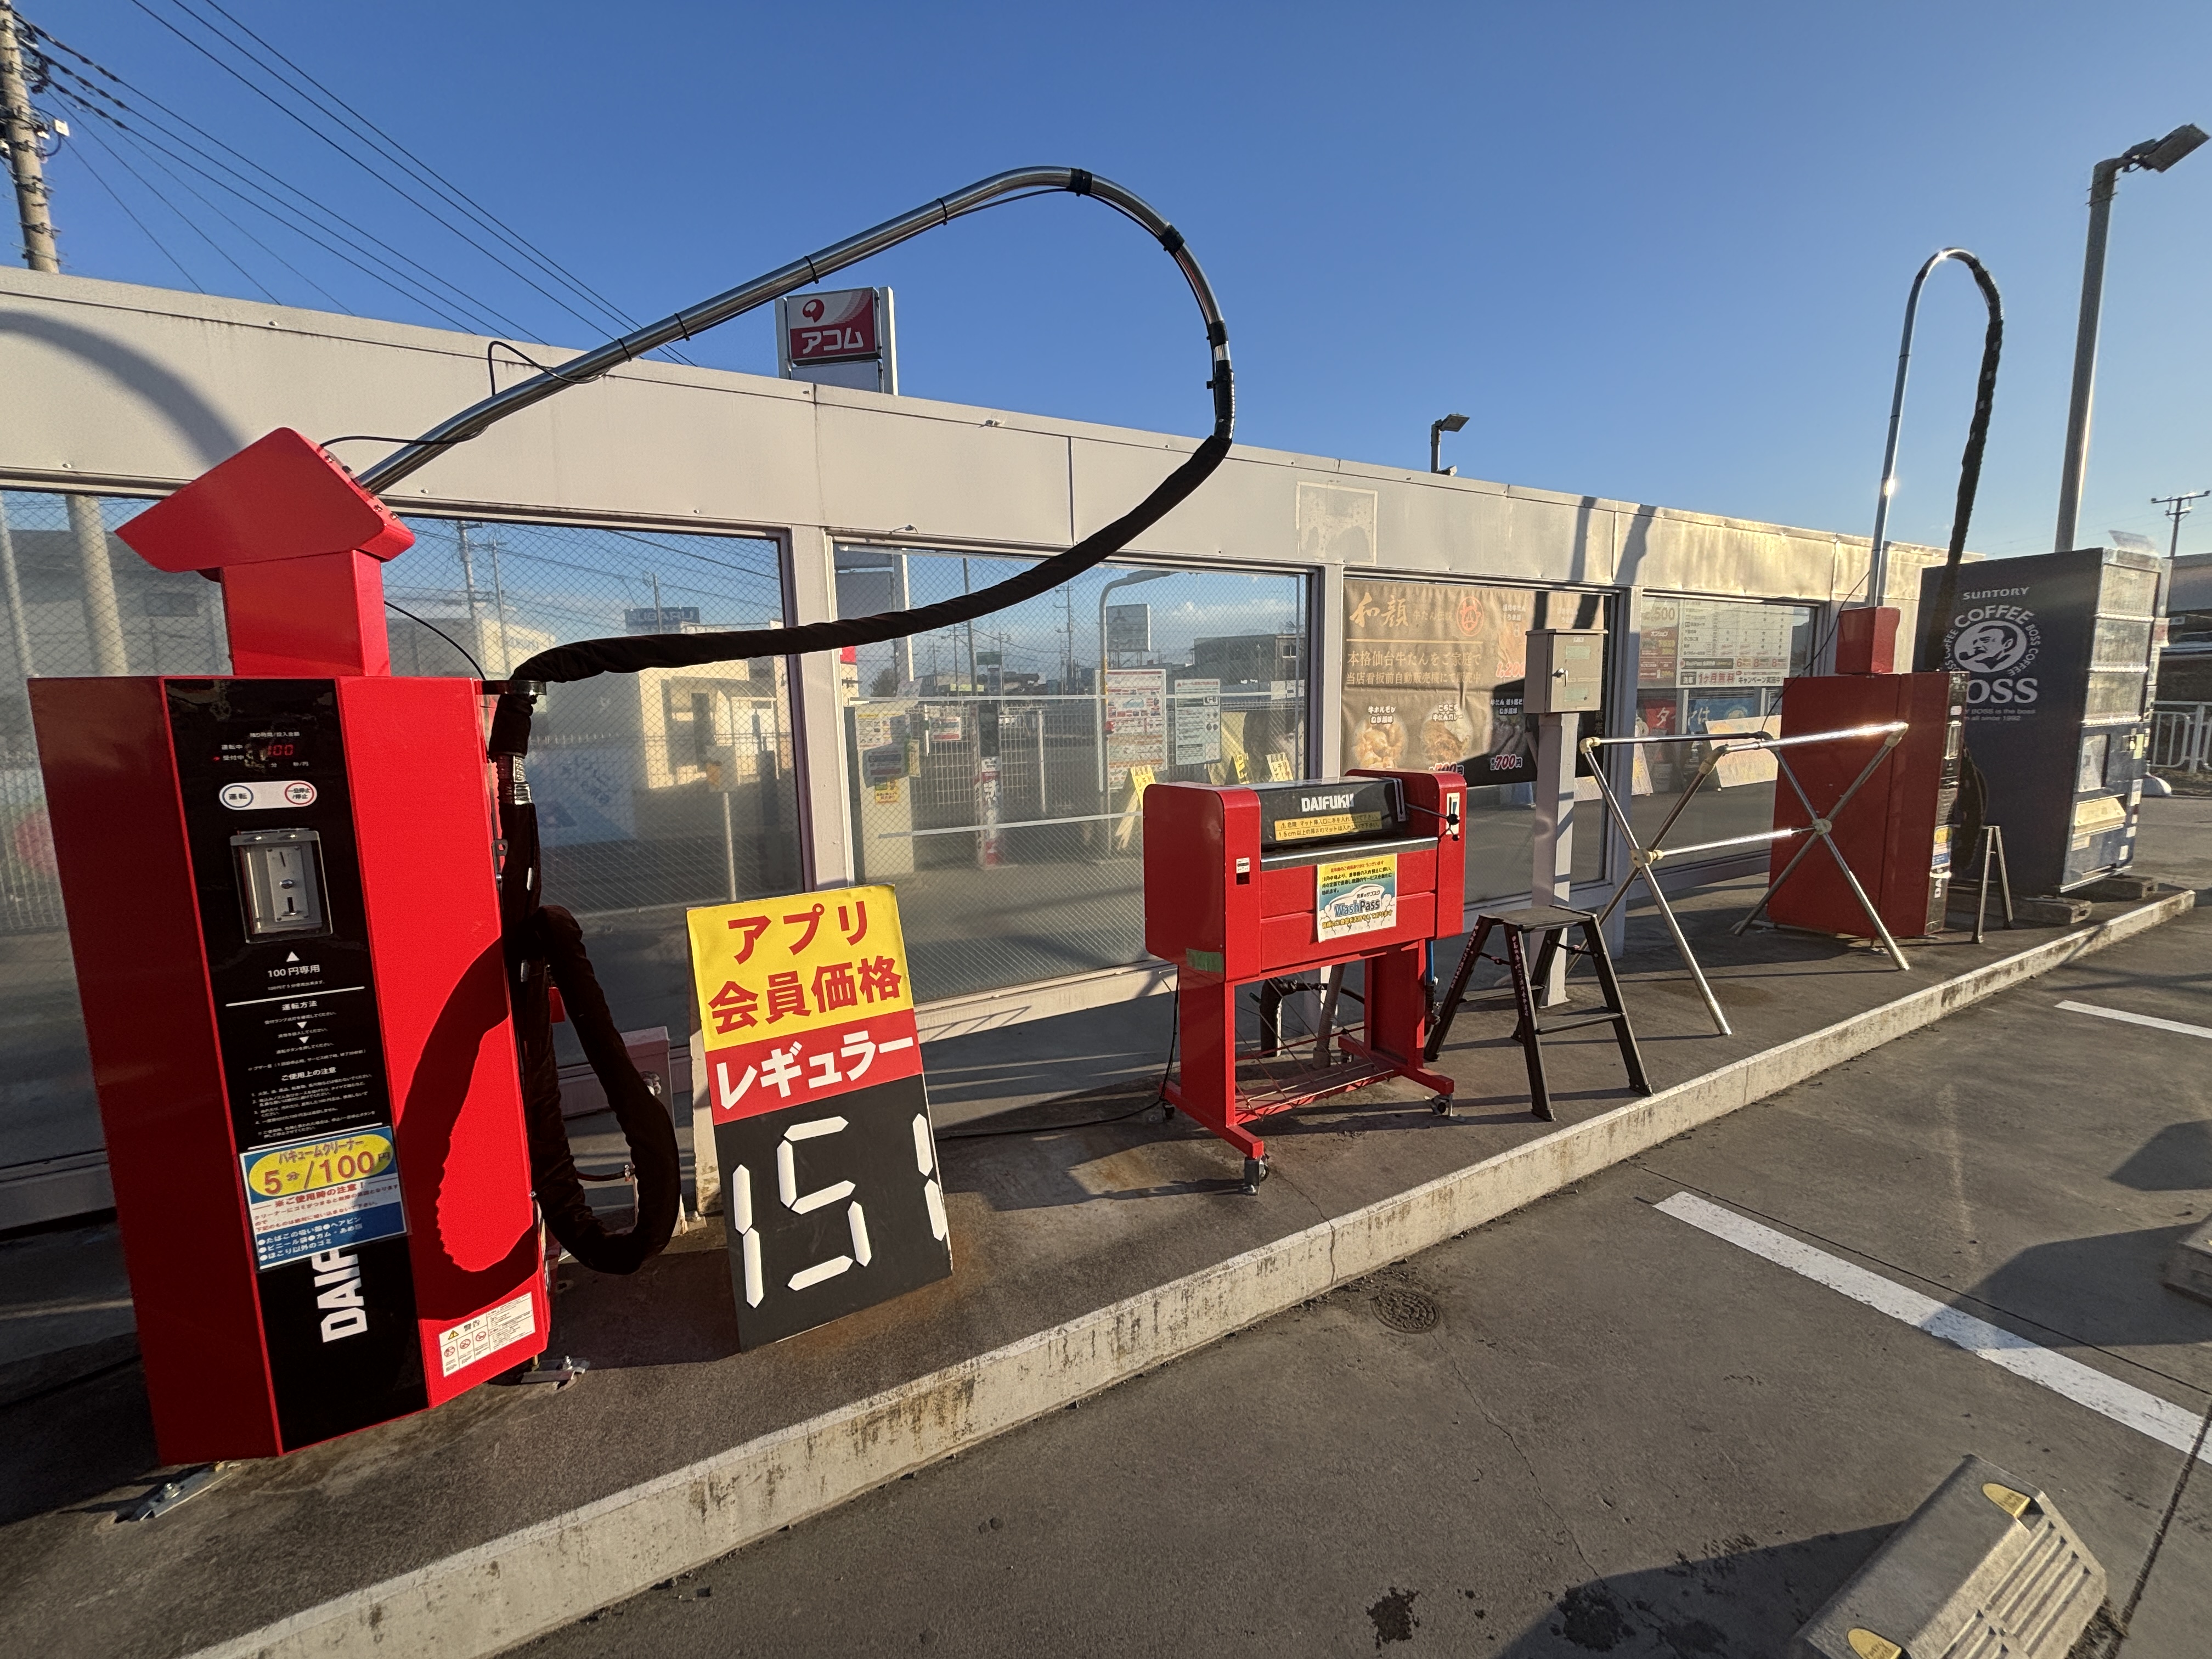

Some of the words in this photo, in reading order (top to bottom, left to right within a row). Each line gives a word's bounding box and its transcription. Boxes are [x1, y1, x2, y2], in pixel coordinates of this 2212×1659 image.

[801, 327, 864, 354] アコム
[1962, 586, 2030, 600] SUNTORY
[1349, 592, 1409, 628] 和顔
[1954, 605, 2035, 628] COFFEE
[2025, 623, 2041, 646] BOSS
[1347, 650, 1480, 667] 本格仙台牛たんをご家庭で
[2007, 648, 2039, 676] COFFEE
[1965, 677, 2038, 704] OSS
[268, 744, 294, 755] 100
[1496, 754, 1523, 770] 700円
[1301, 793, 1355, 812] DAIFUKU
[1334, 899, 1381, 917] WashPass
[727, 900, 868, 965] アプリ
[267, 964, 320, 978] 100円専用
[281, 1000, 318, 1011] 運転方法
[708, 955, 902, 1034] 会員価格
[281, 1066, 336, 1081] ご使用上の注意
[716, 1030, 913, 1110] レギュラー
[278, 1138, 365, 1165] バキュームクリーナー
[732, 1113, 947, 1308] 151
[255, 1218, 268, 1227] ので
[311, 1249, 368, 1343] DAIF
